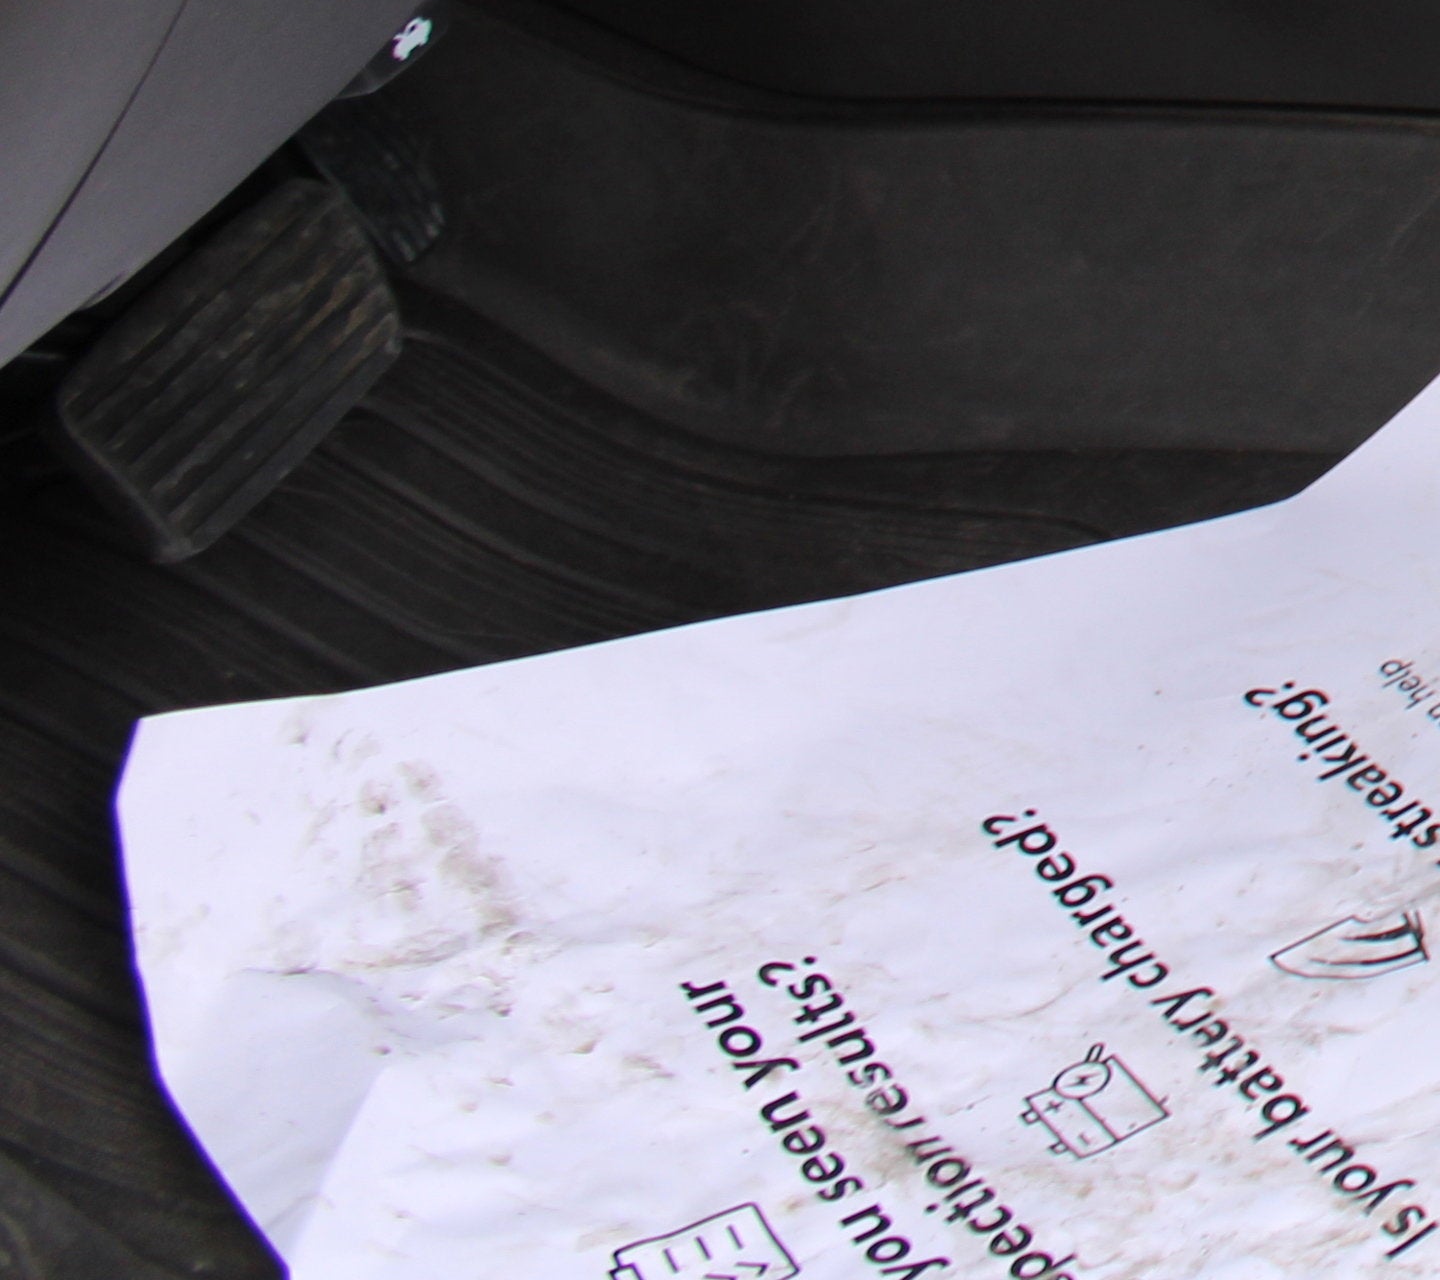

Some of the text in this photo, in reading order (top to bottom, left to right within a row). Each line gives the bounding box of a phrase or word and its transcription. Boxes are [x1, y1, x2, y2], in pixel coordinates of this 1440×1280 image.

[1379, 660, 1435, 709] help
[680, 981, 950, 1280] you seen your
[758, 956, 1075, 1280] pection results?
[982, 809, 1438, 1259] Is your battery charged?
